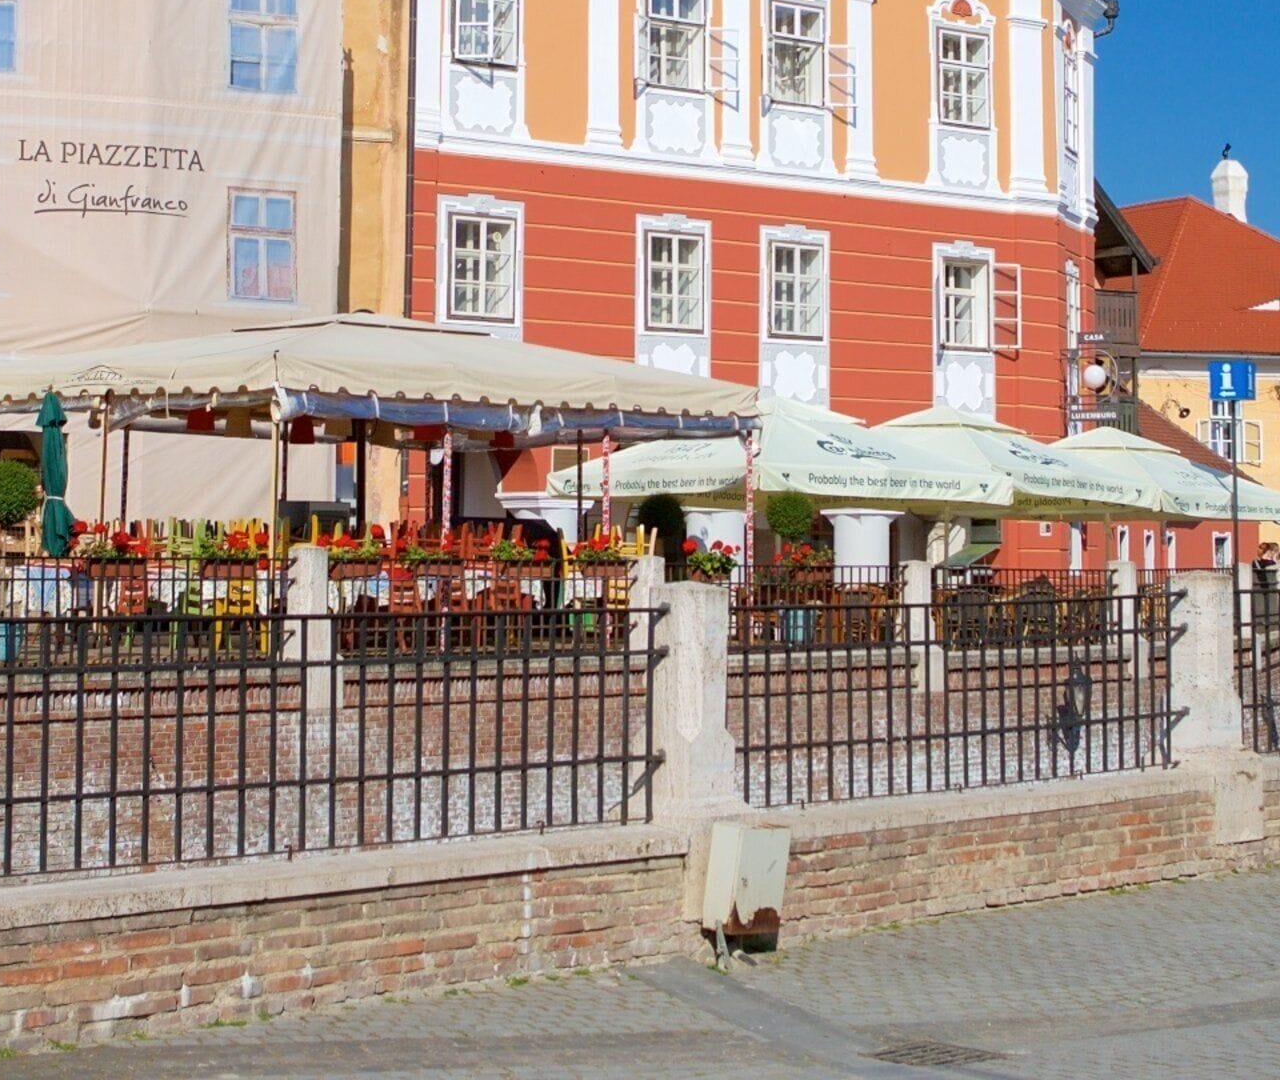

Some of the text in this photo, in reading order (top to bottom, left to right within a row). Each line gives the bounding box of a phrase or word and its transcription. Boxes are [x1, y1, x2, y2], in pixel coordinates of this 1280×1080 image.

[18, 139, 205, 172] LA PIAZZETTA
[37, 179, 189, 219] di Gianfranco
[1083, 333, 1105, 341] CASA
[615, 479, 646, 491] Probably
[647, 478, 660, 489] the
[662, 478, 678, 489] best
[680, 478, 697, 488] beer
[698, 476, 705, 487] in
[808, 472, 961, 490] Probably the best beer in the world
